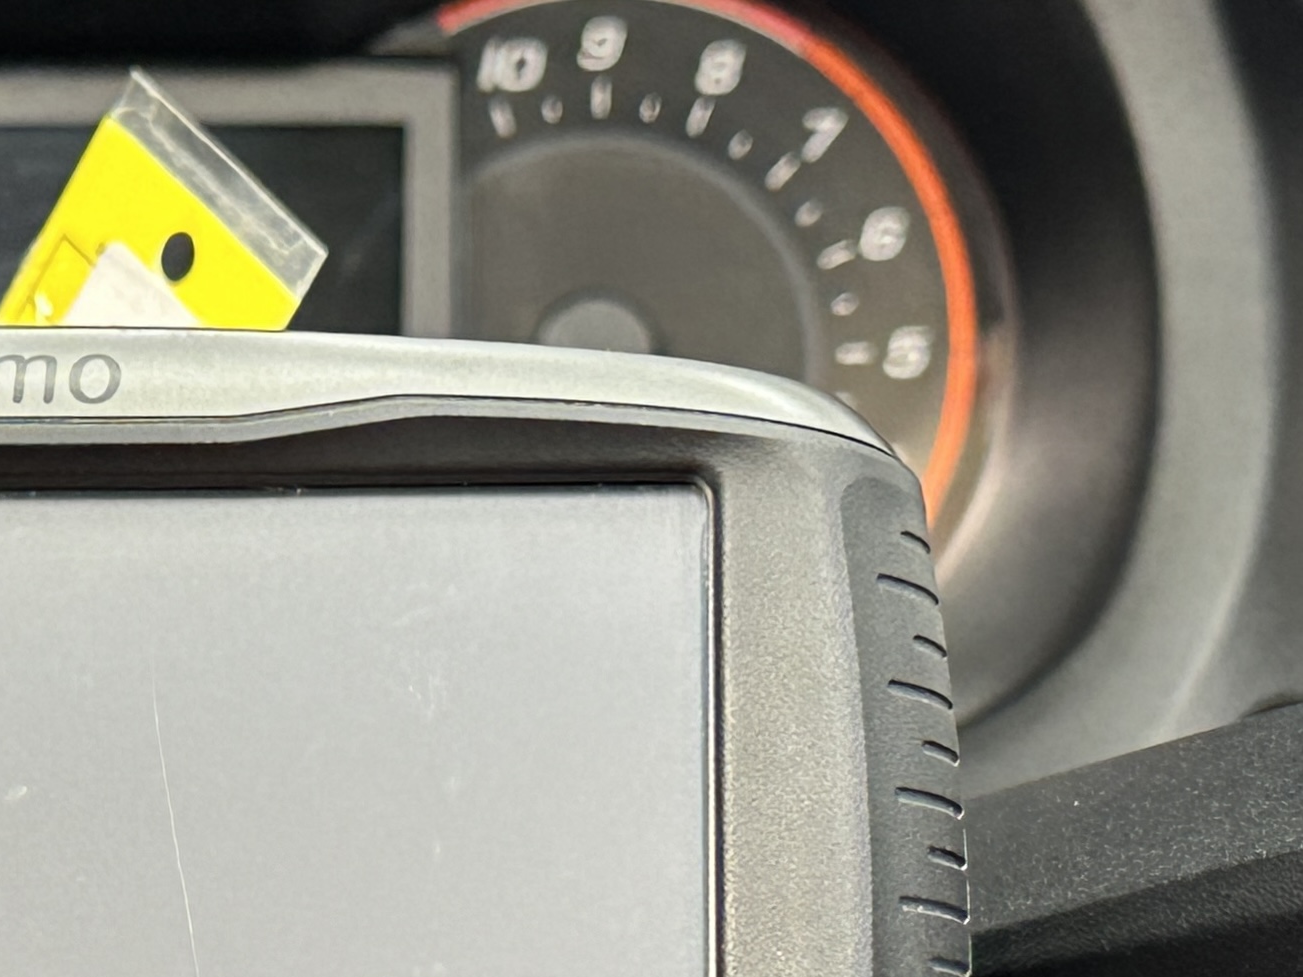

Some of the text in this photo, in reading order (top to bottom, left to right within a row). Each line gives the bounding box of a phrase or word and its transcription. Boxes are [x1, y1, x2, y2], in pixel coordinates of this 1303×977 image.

[477, 37, 547, 92] 10
[578, 15, 627, 71] 9
[802, 106, 848, 163] 7
